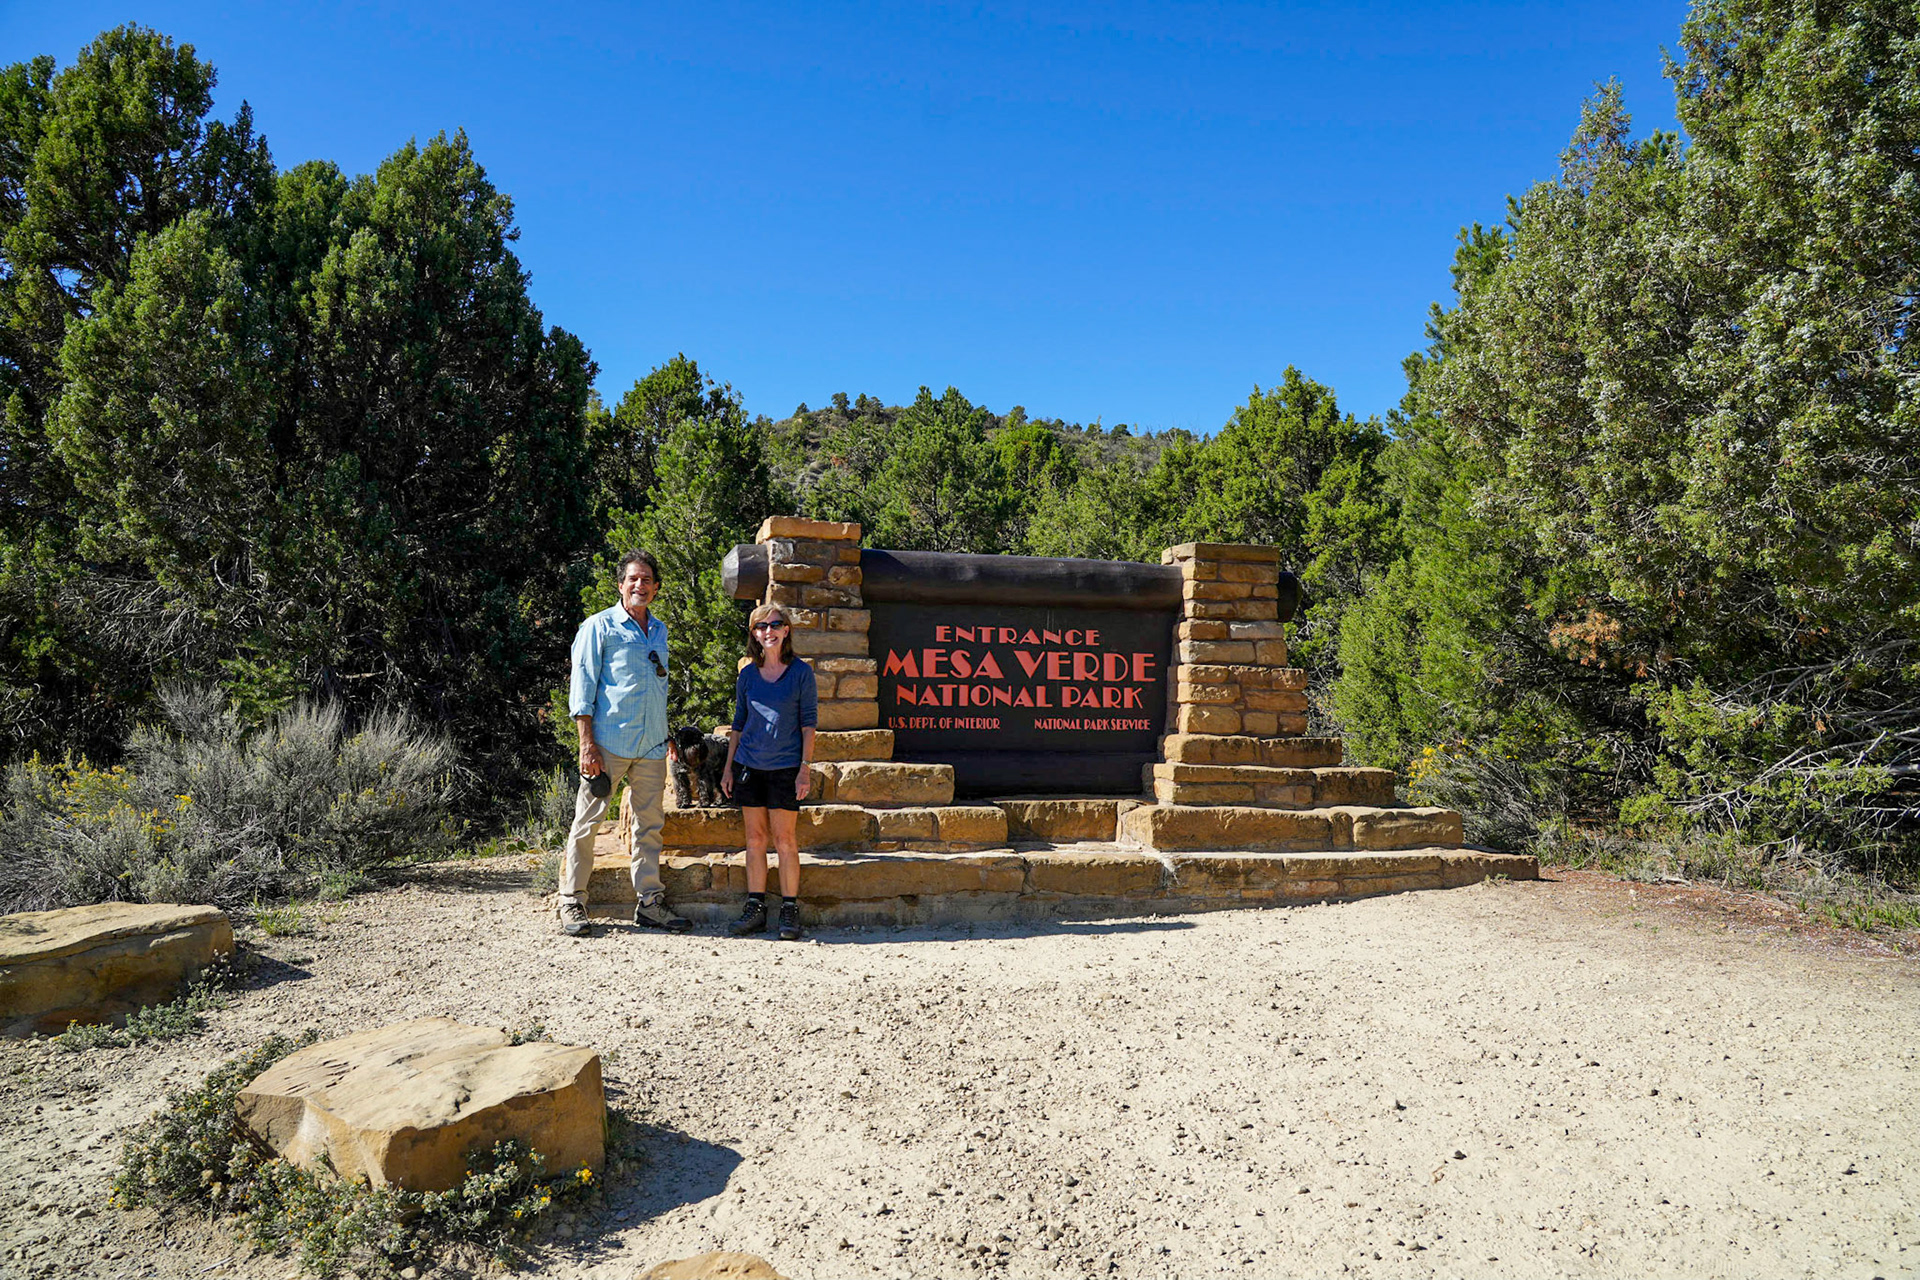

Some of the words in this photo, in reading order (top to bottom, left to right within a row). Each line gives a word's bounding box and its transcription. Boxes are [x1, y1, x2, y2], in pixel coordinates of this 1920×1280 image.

[936, 625, 1100, 646] ENTRANCE
[883, 648, 1005, 678] MESA
[1014, 650, 1156, 682] VERDE
[896, 684, 1053, 708] NATIONAL
[1062, 686, 1144, 708] PARK
[889, 718, 907, 729] U.S.
[910, 718, 936, 729] DEPT.
[939, 718, 952, 729] OF
[954, 718, 1000, 730] INTERIOR
[1034, 718, 1082, 730] NATIONAL
[1084, 719, 1110, 730] PARK
[1111, 719, 1150, 730] SERVICE
